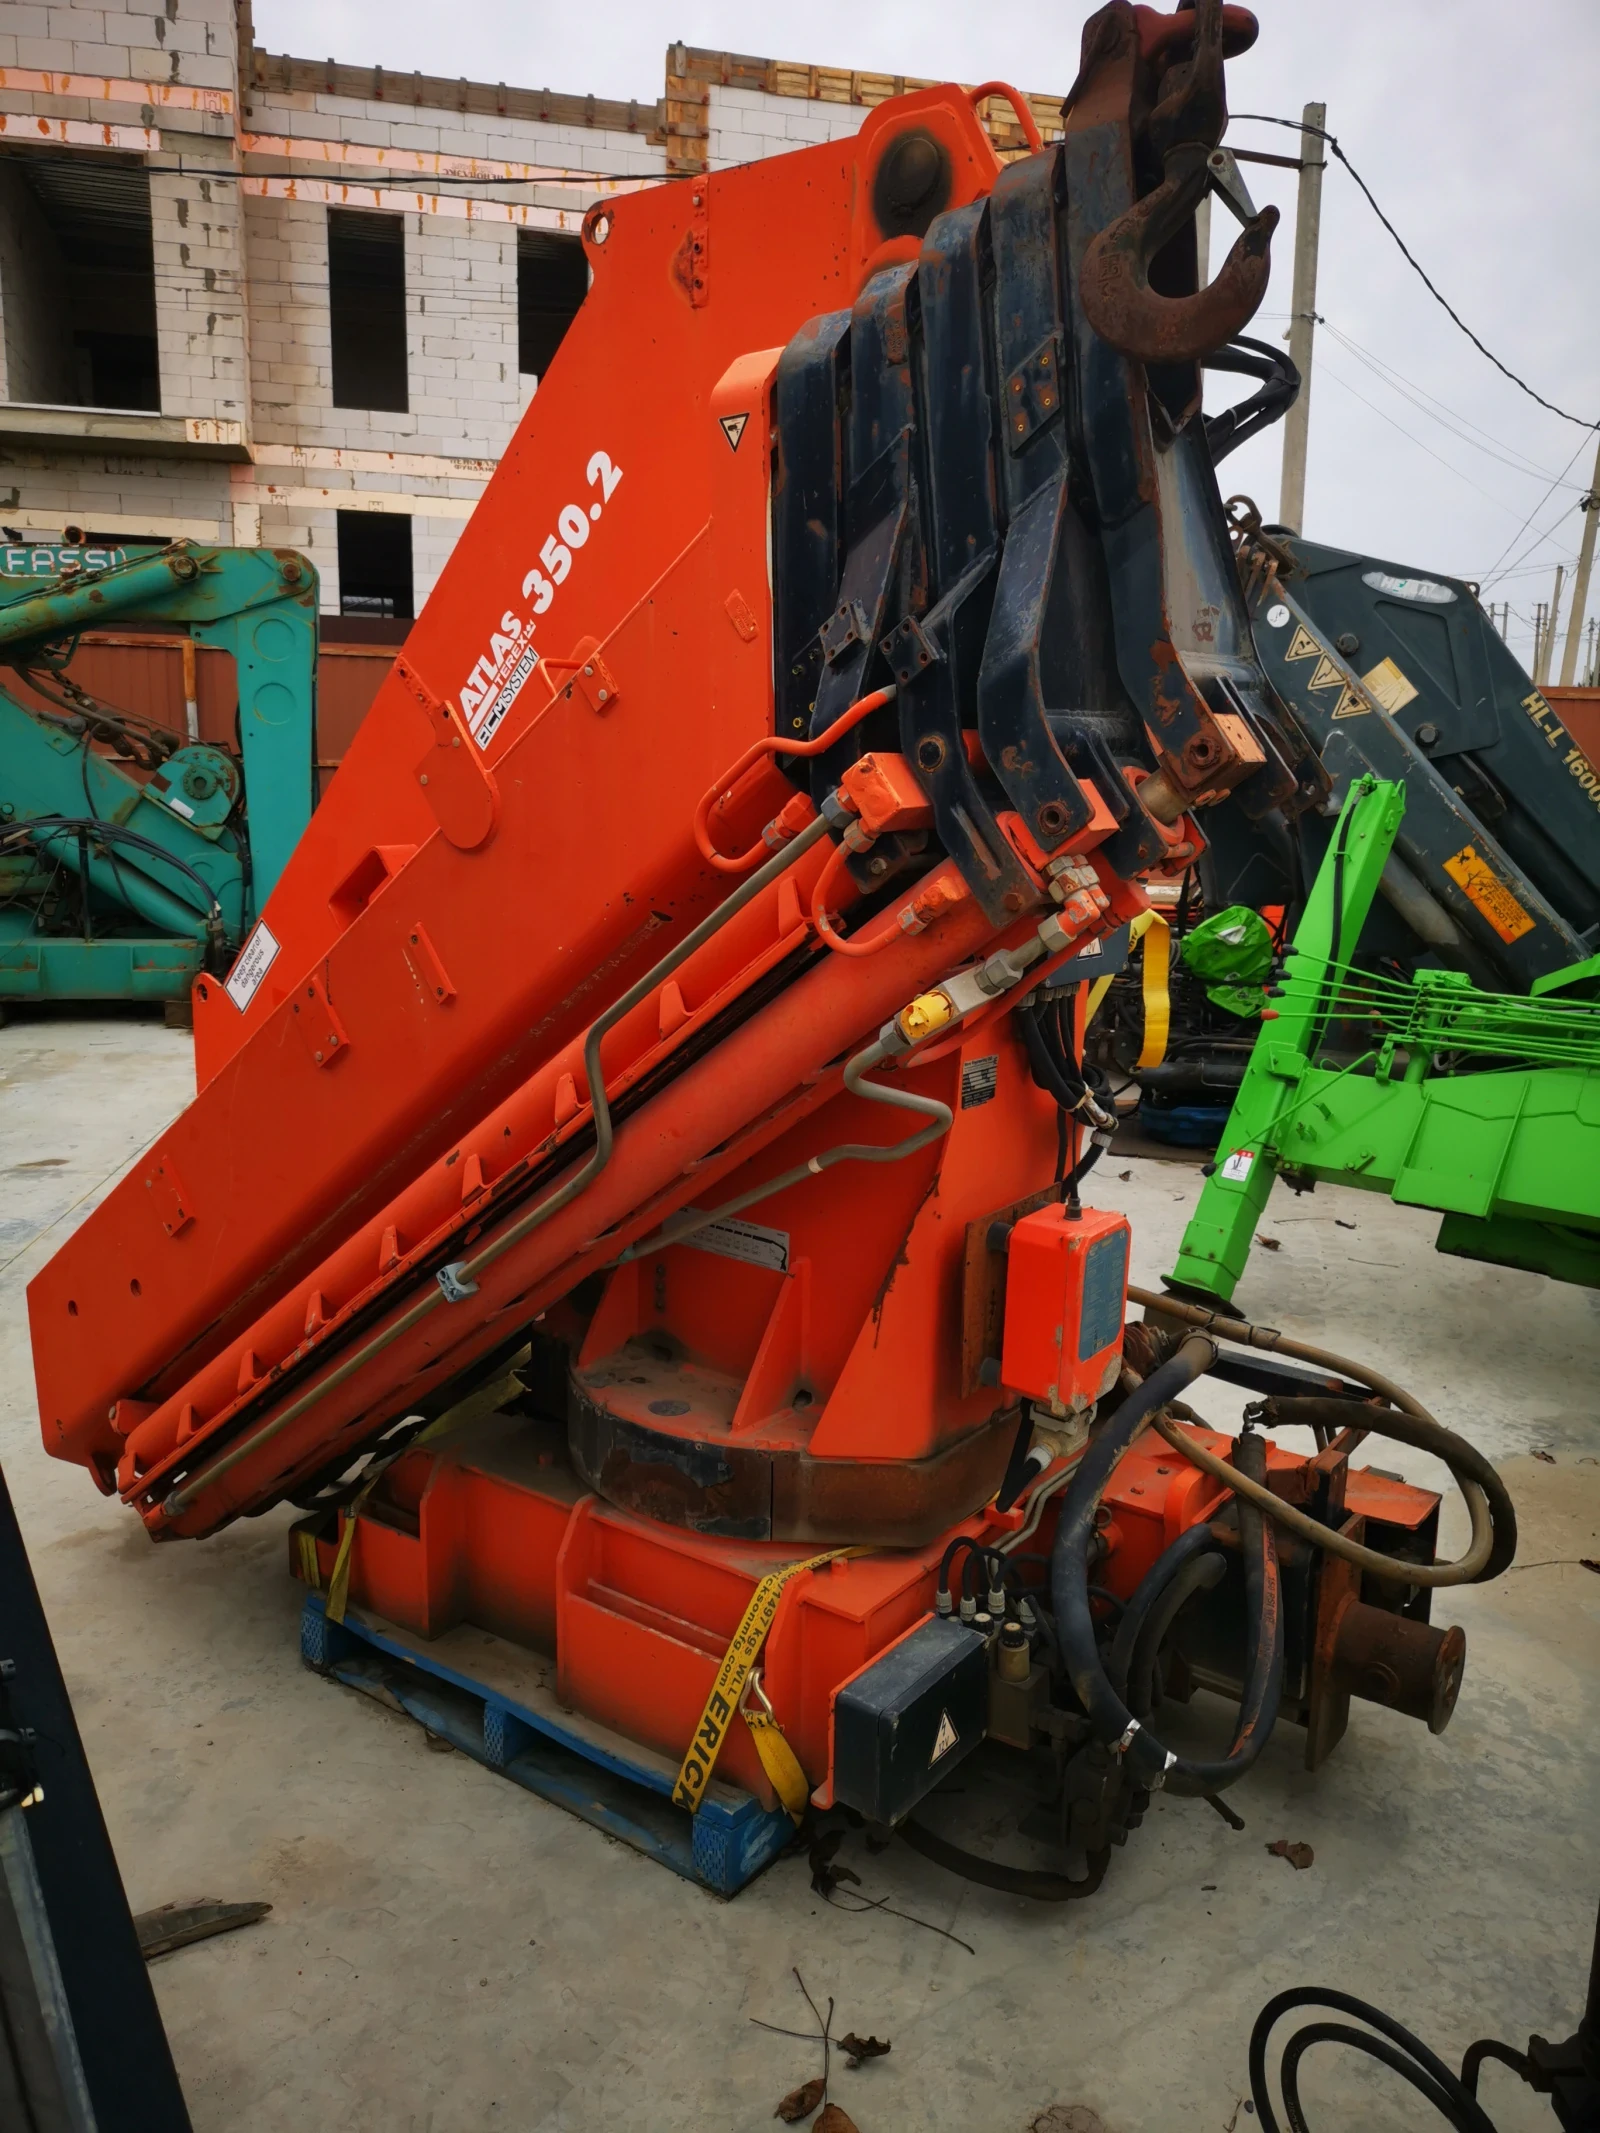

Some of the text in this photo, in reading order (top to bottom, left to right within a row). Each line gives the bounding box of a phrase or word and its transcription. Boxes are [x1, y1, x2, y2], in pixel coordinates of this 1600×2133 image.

[522, 451, 625, 614] 350.2
[6, 549, 118, 573] FASSI
[459, 610, 522, 722] ATLAS
[494, 633, 529, 686] TEREX
[1520, 691, 1565, 748] HL-L
[232, 963, 247, 984] Keep
[243, 944, 259, 966] clear
[241, 948, 264, 988] dangerous
[251, 966, 263, 986] area
[743, 1628, 763, 1656] kgs
[726, 1663, 747, 1697] WLL
